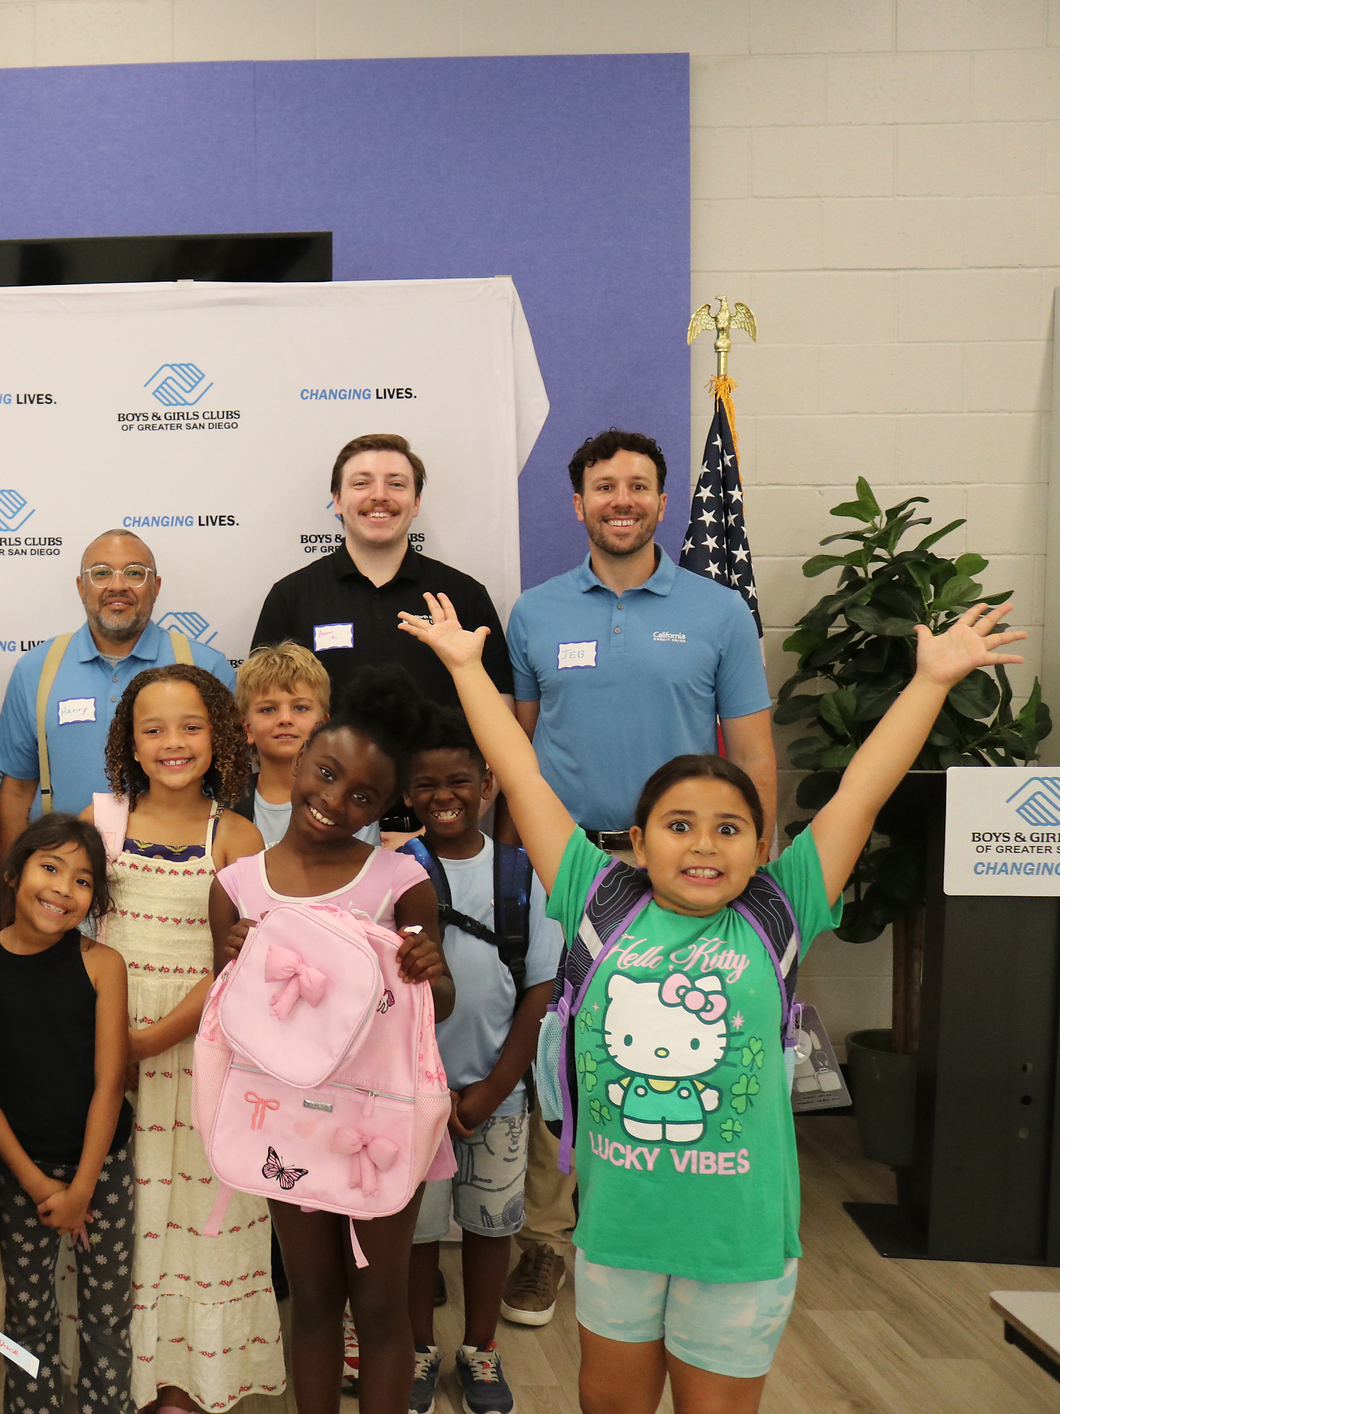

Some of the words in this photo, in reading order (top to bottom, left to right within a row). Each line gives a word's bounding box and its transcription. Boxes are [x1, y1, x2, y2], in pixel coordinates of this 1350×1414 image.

[16, 394, 56, 404] LIVES.
[300, 388, 372, 400] CHANGING
[376, 388, 416, 400] LIVES.
[118, 412, 150, 422] BOYS
[152, 412, 162, 422] &
[164, 410, 200, 420] GIRLS
[202, 410, 240, 420] CLUBS
[122, 424, 134, 432] OF
[136, 422, 182, 432] GREATER
[186, 422, 206, 430] SAN
[208, 422, 238, 430] DIEGO
[122, 516, 195, 528] CHANGING
[198, 514, 240, 526] LIVES.
[24, 536, 62, 546] CLUBS
[300, 534, 332, 544] BOYS
[304, 546, 318, 554] OF
[653, 631, 686, 640] California
[560, 650, 584, 660] JEB
[972, 832, 1010, 842] BOYS
[1014, 832, 1026, 842] &
[1030, 832, 1060, 842] GIR
[976, 844, 992, 854] OF
[996, 846, 1052, 854] GREATER
[601, 934, 664, 970] Hello
[670, 937, 750, 984] Kitty
[588, 1131, 660, 1172] LUCKY
[669, 1148, 751, 1176] VIBES
